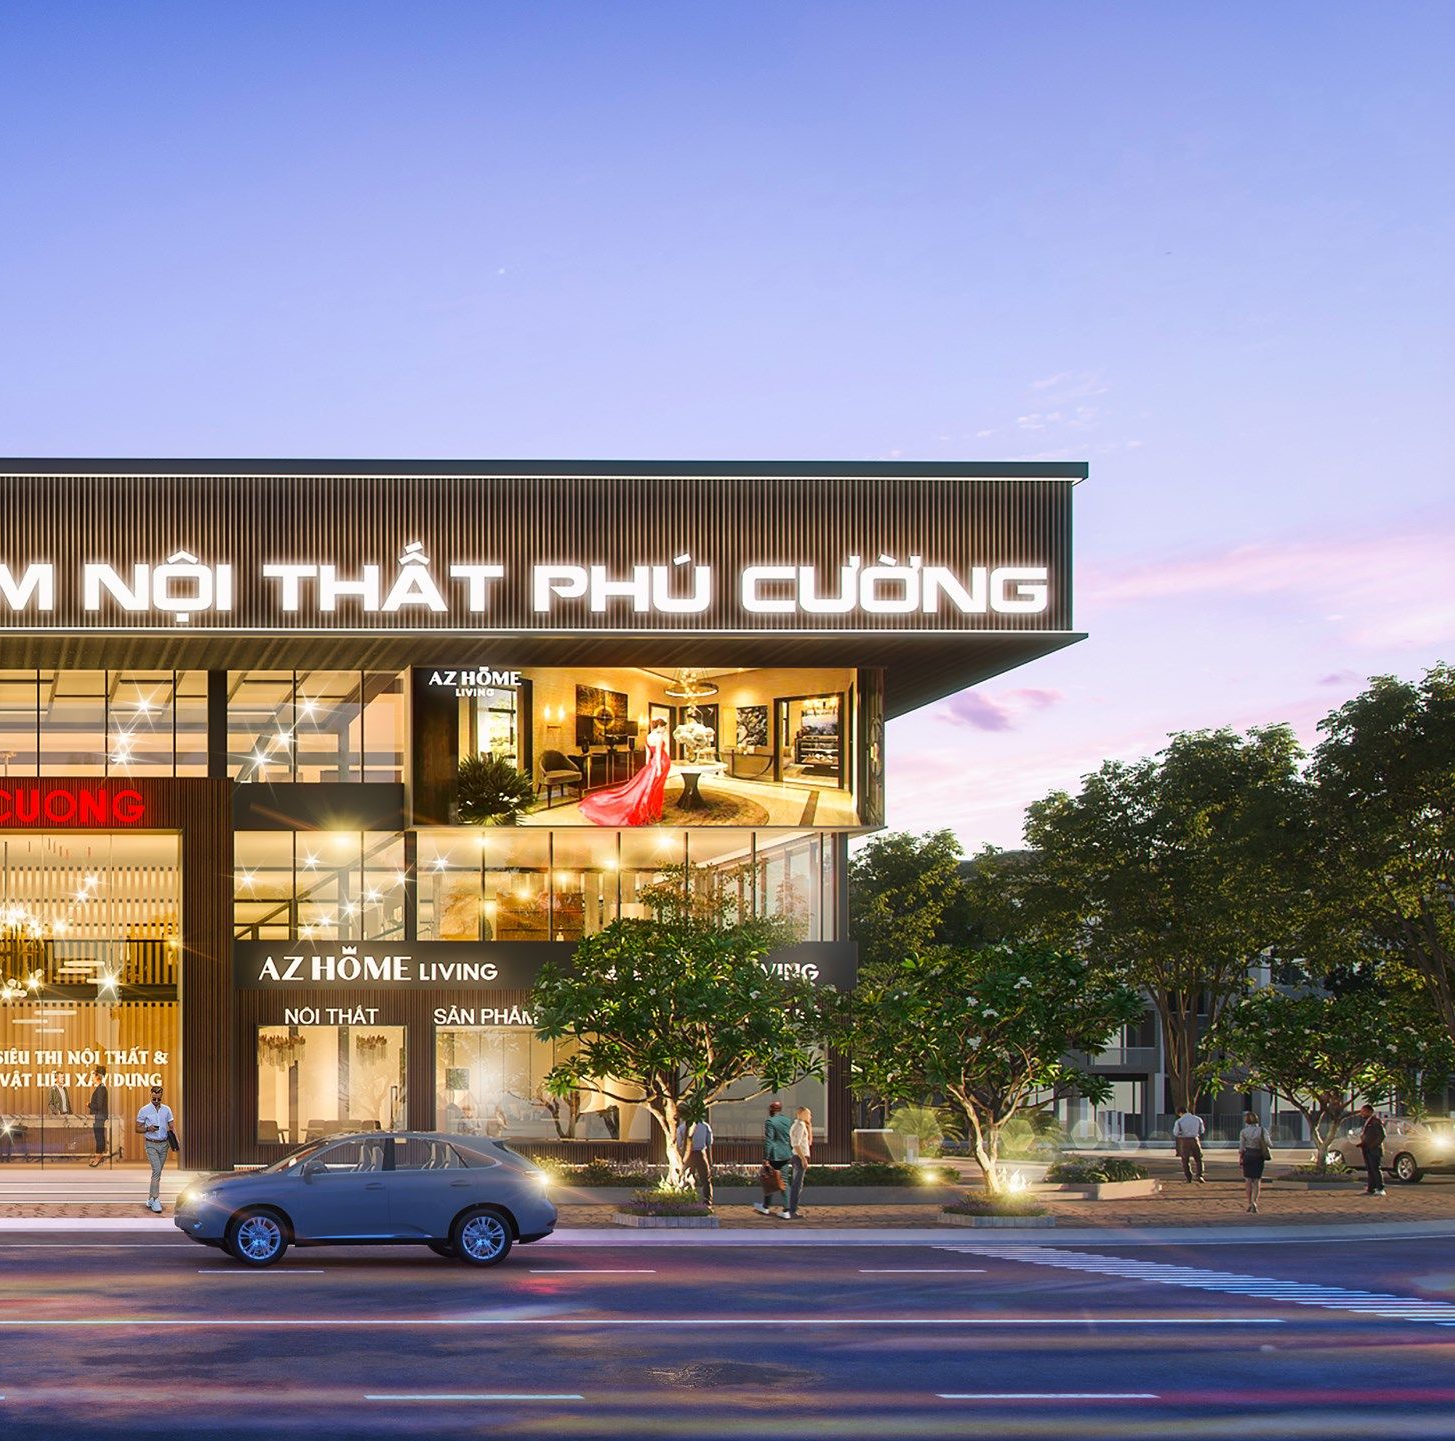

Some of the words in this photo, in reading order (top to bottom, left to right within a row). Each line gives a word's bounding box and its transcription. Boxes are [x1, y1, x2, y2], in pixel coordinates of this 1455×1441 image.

[85, 550, 232, 623] NỘI
[262, 540, 504, 612] THẤT
[533, 553, 711, 613] PHÚ
[742, 554, 1048, 613] CƯỜNG
[429, 671, 457, 686] AZ
[455, 687, 495, 697] LIVING
[258, 956, 305, 981] AZ
[311, 956, 412, 981] HOME
[419, 962, 499, 981] LIVING
[35, 1050, 63, 1068] THỊ
[68, 1047, 100, 1068] NỘI
[153, 1051, 168, 1065] &
